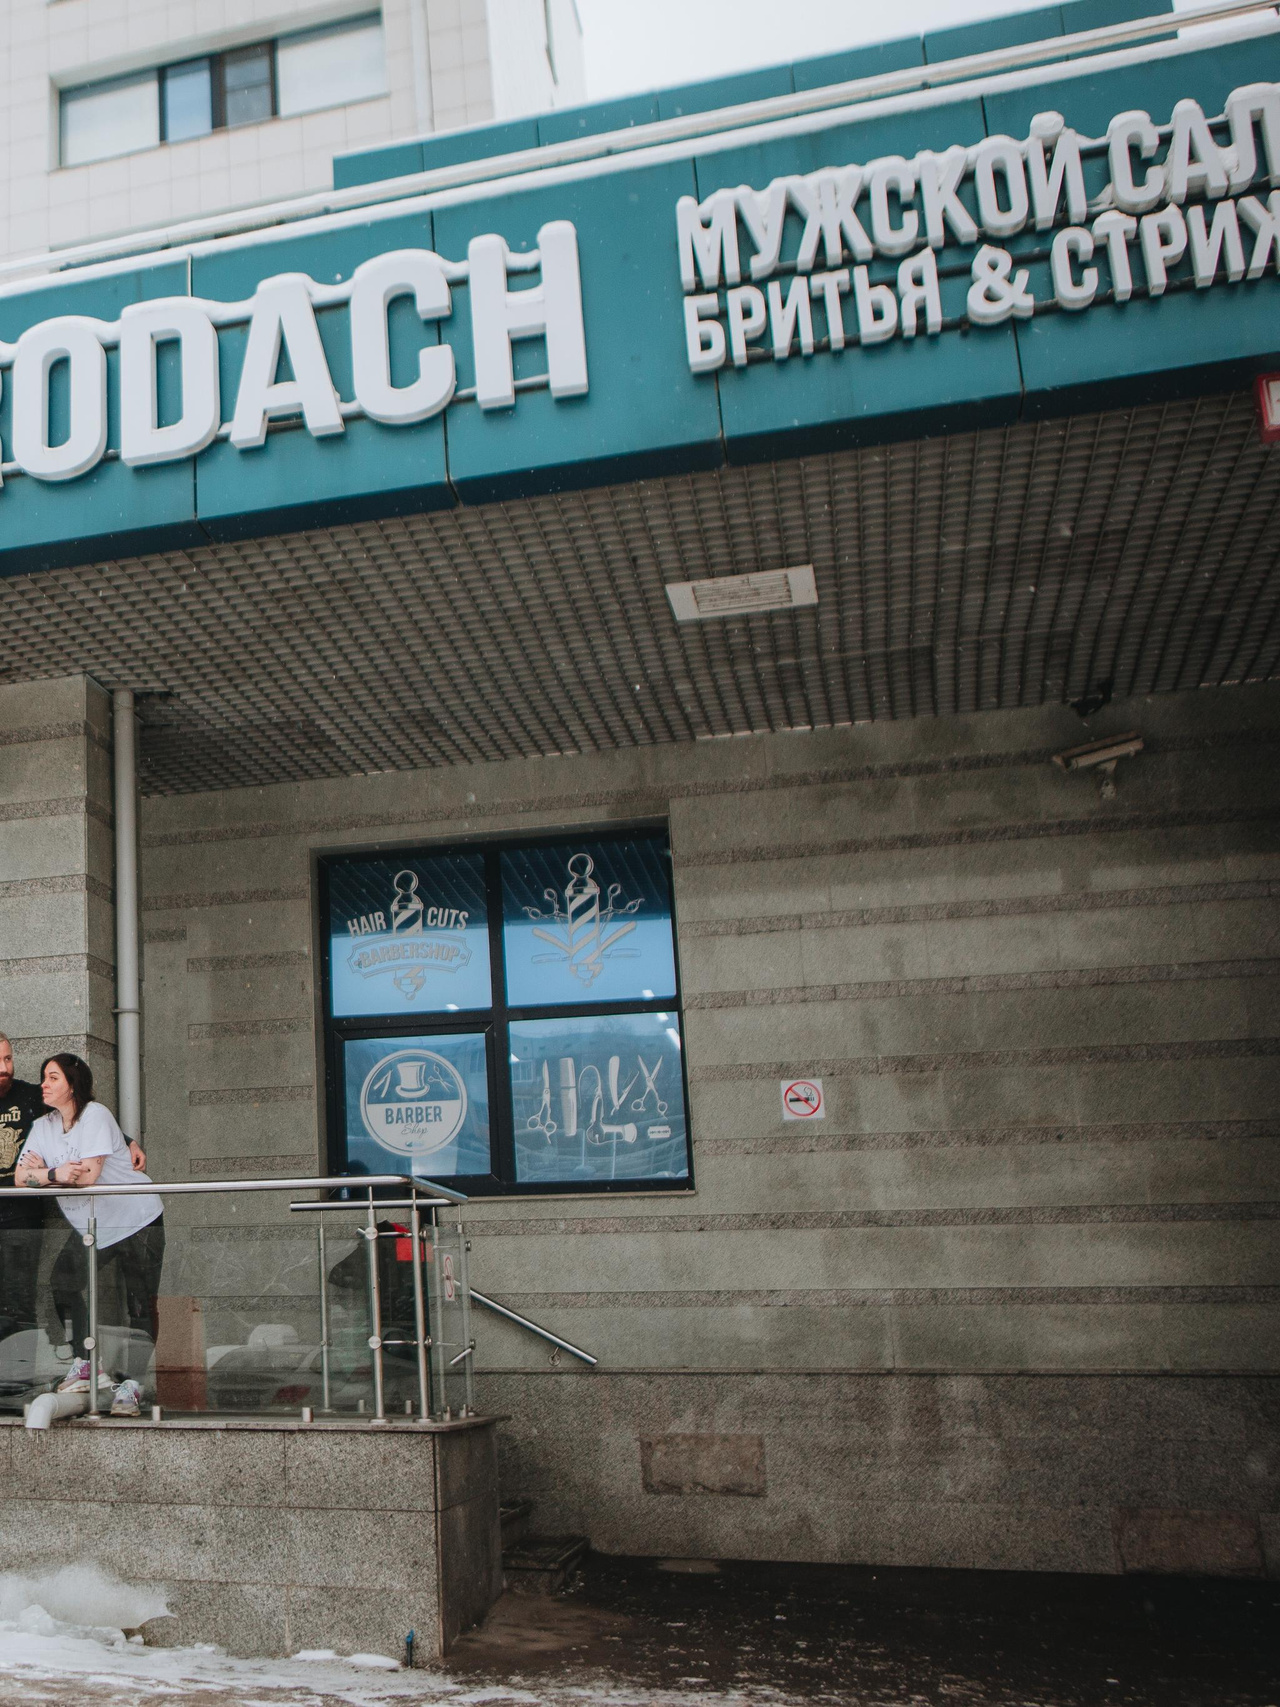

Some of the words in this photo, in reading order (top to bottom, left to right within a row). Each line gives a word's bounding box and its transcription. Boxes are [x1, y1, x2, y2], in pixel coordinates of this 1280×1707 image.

[676, 111, 1088, 292] МУЖСКОЙ
[683, 246, 943, 374] БРИТЬЯ
[966, 244, 1035, 327] &
[347, 911, 387, 939] HAIR
[426, 906, 469, 931] CUTS
[359, 941, 460, 969] BARBERSHOP
[385, 1105, 443, 1124] BARBER
[401, 1122, 429, 1139] Shop
